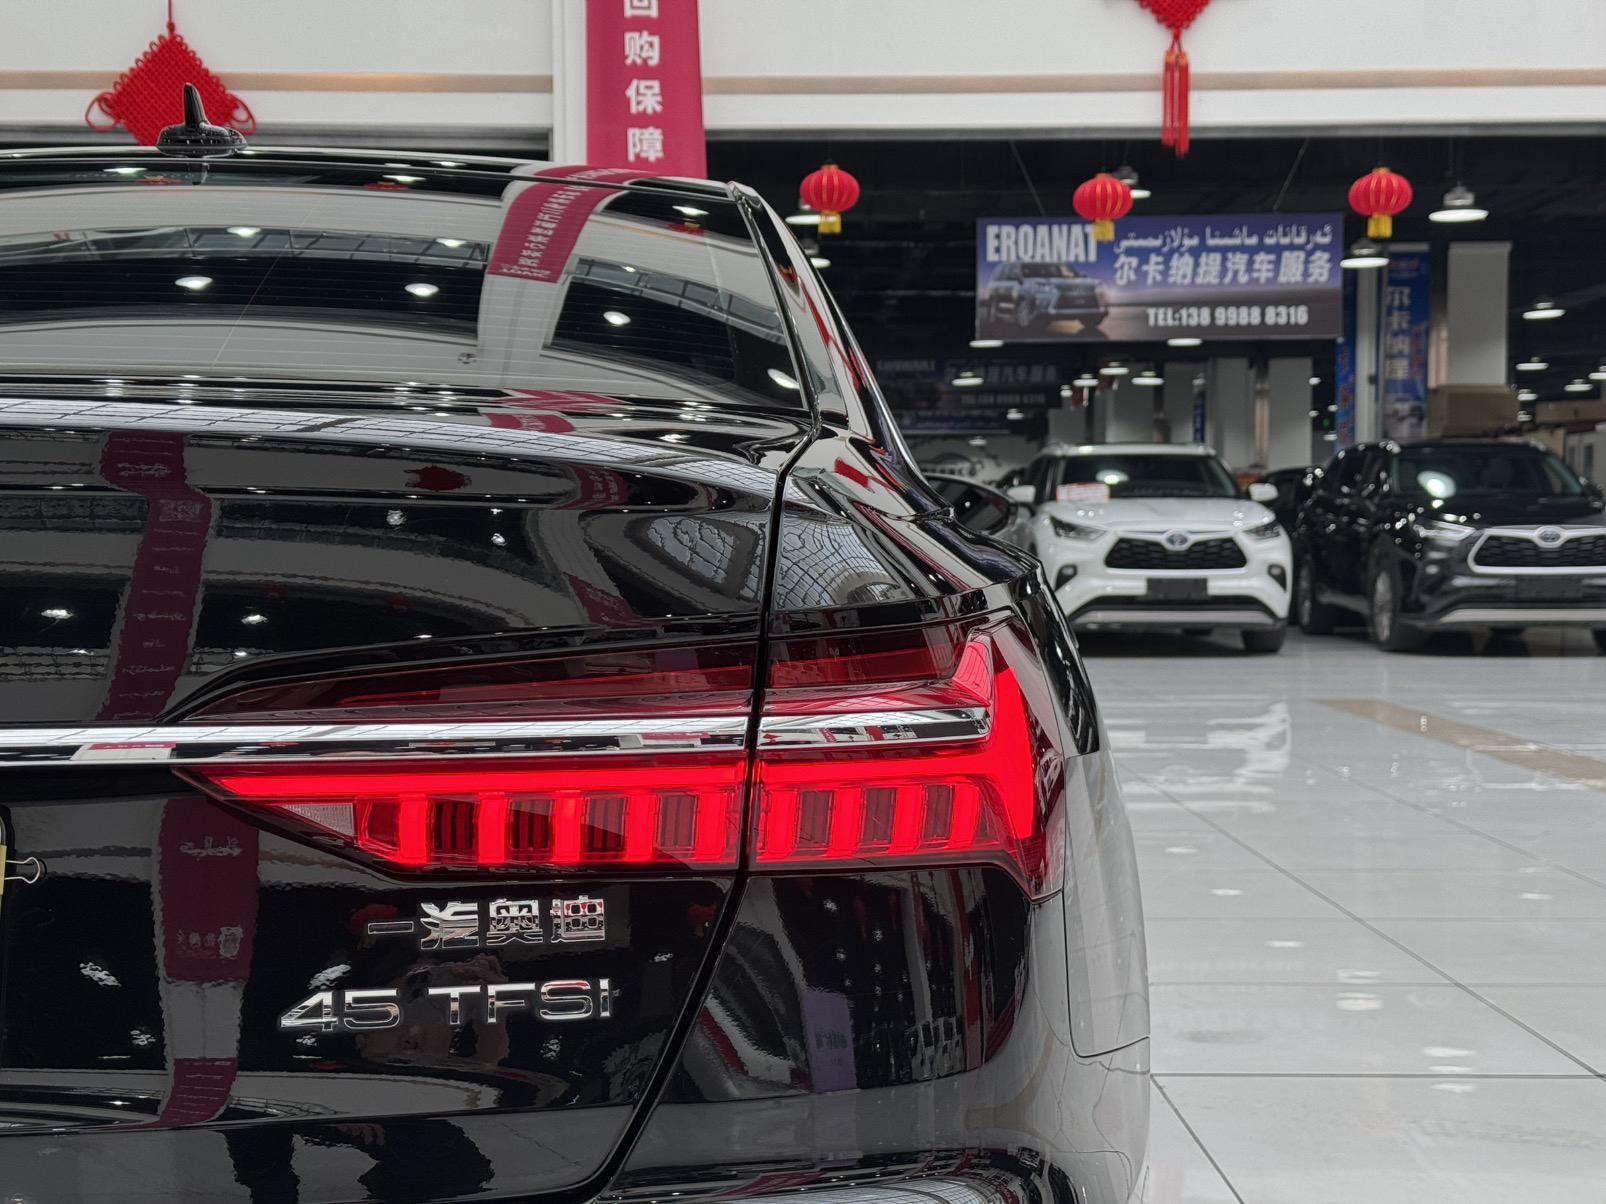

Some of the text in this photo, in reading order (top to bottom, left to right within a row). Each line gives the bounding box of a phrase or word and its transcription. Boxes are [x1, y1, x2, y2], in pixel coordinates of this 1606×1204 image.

[1114, 251, 1333, 286] 尔卡纳提汽车服务
[367, 895, 606, 950] 一汽奥迪
[279, 987, 401, 1031] 45
